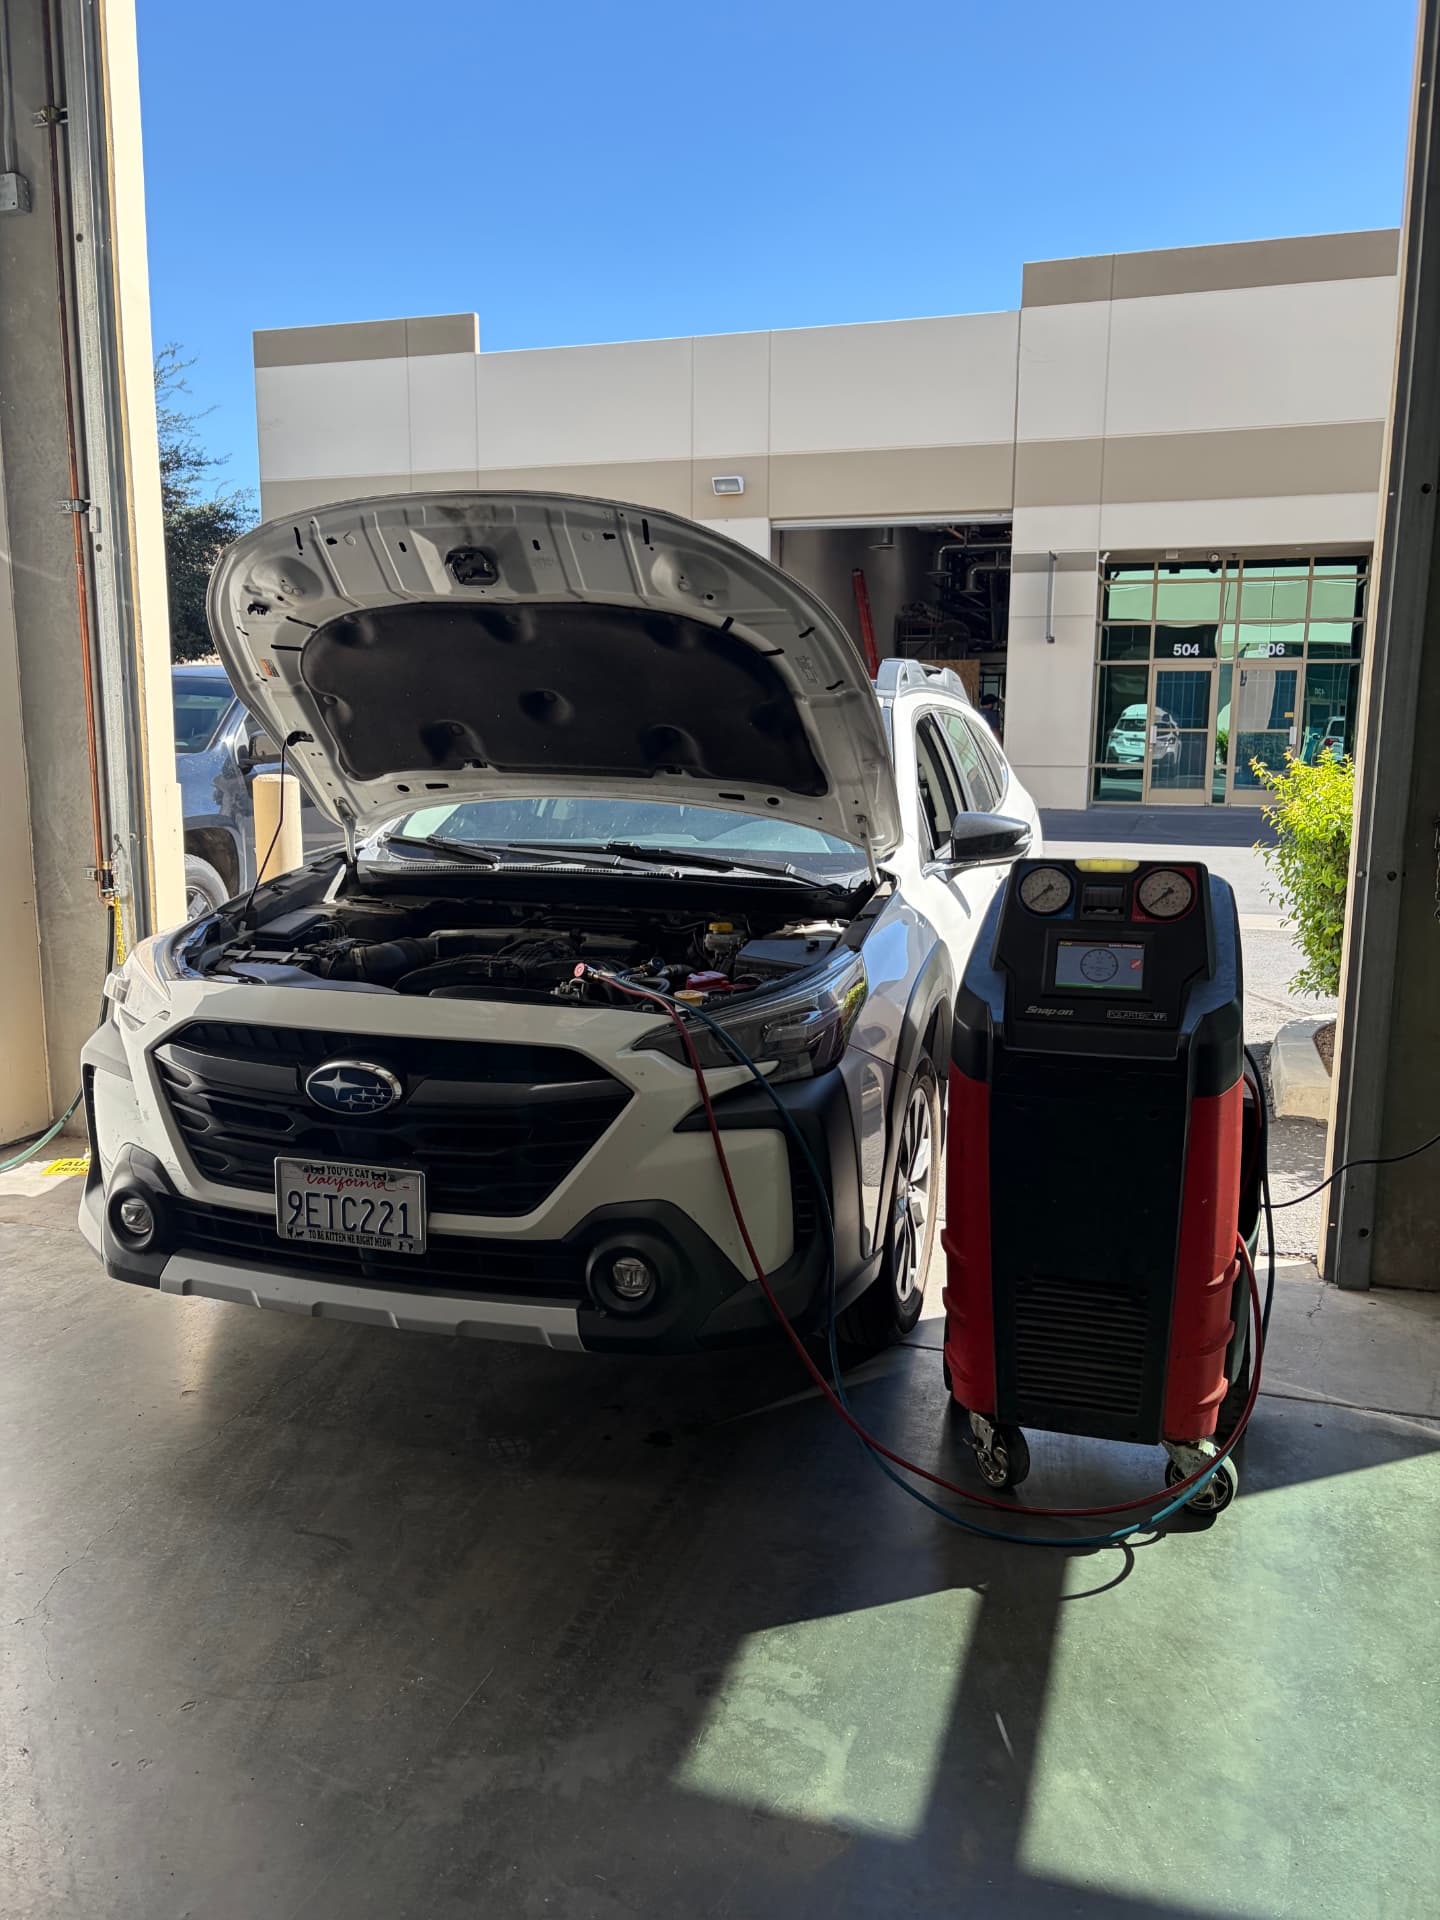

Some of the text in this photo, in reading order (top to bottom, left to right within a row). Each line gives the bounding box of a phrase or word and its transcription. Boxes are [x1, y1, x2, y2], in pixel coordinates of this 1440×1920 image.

[1173, 643, 1200, 656] 504
[1258, 643, 1285, 656] 506
[1024, 1005, 1074, 1016] Snap-on
[327, 1165, 369, 1178] YOU'VE CAT
[307, 1174, 396, 1192] California
[287, 1190, 414, 1239] 9ETC221
[308, 1229, 317, 1239] TO
[317, 1230, 325, 1240] BE
[325, 1231, 346, 1242] KITTEN
[375, 1236, 392, 1248] MEOW
